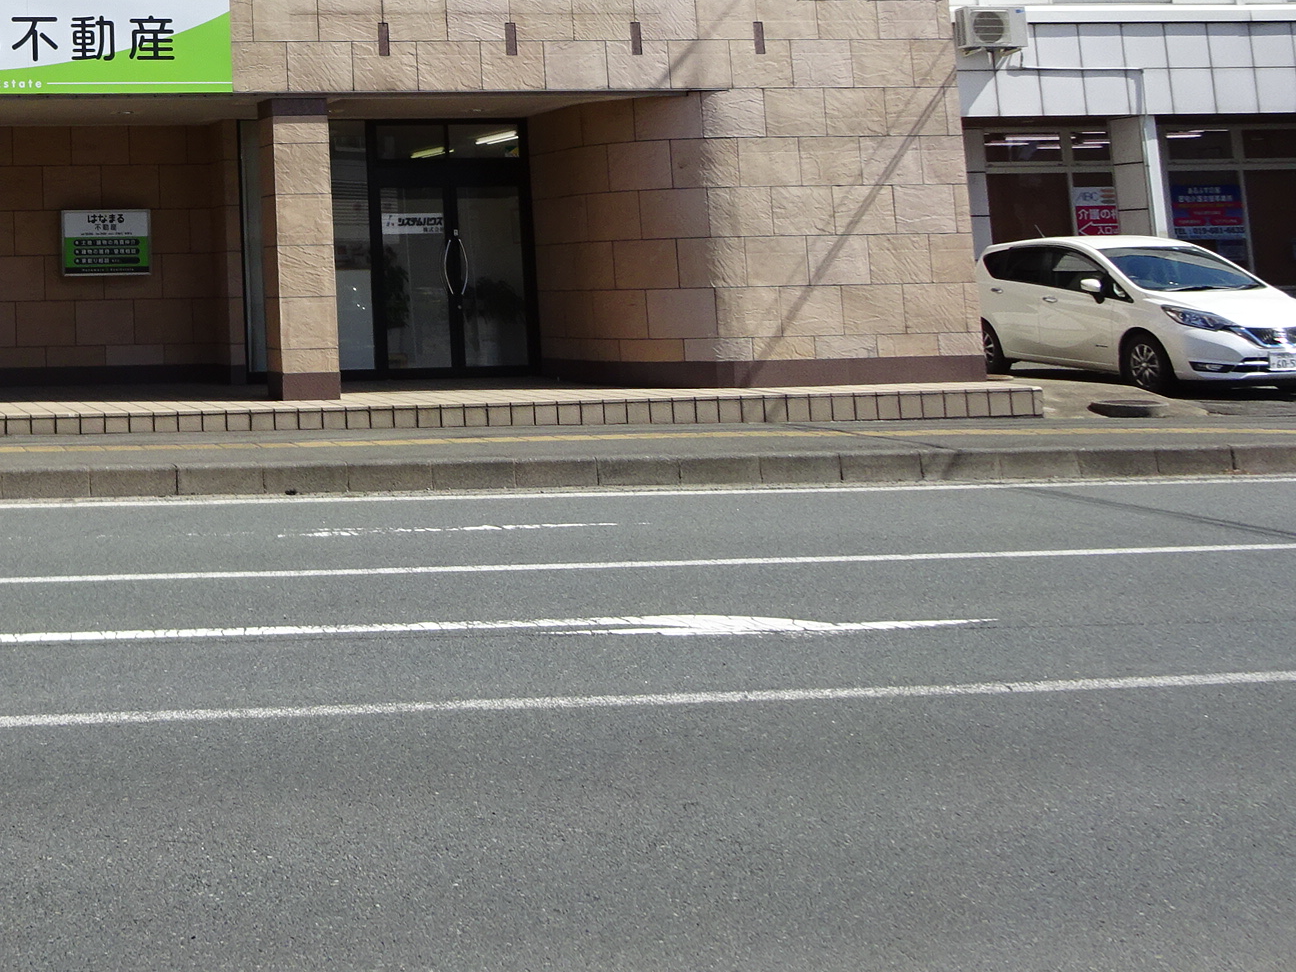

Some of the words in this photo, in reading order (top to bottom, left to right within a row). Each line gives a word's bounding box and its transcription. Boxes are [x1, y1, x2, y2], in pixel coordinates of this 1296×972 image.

[87, 214, 125, 223] はなまる
[397, 217, 443, 226] システムハウス
